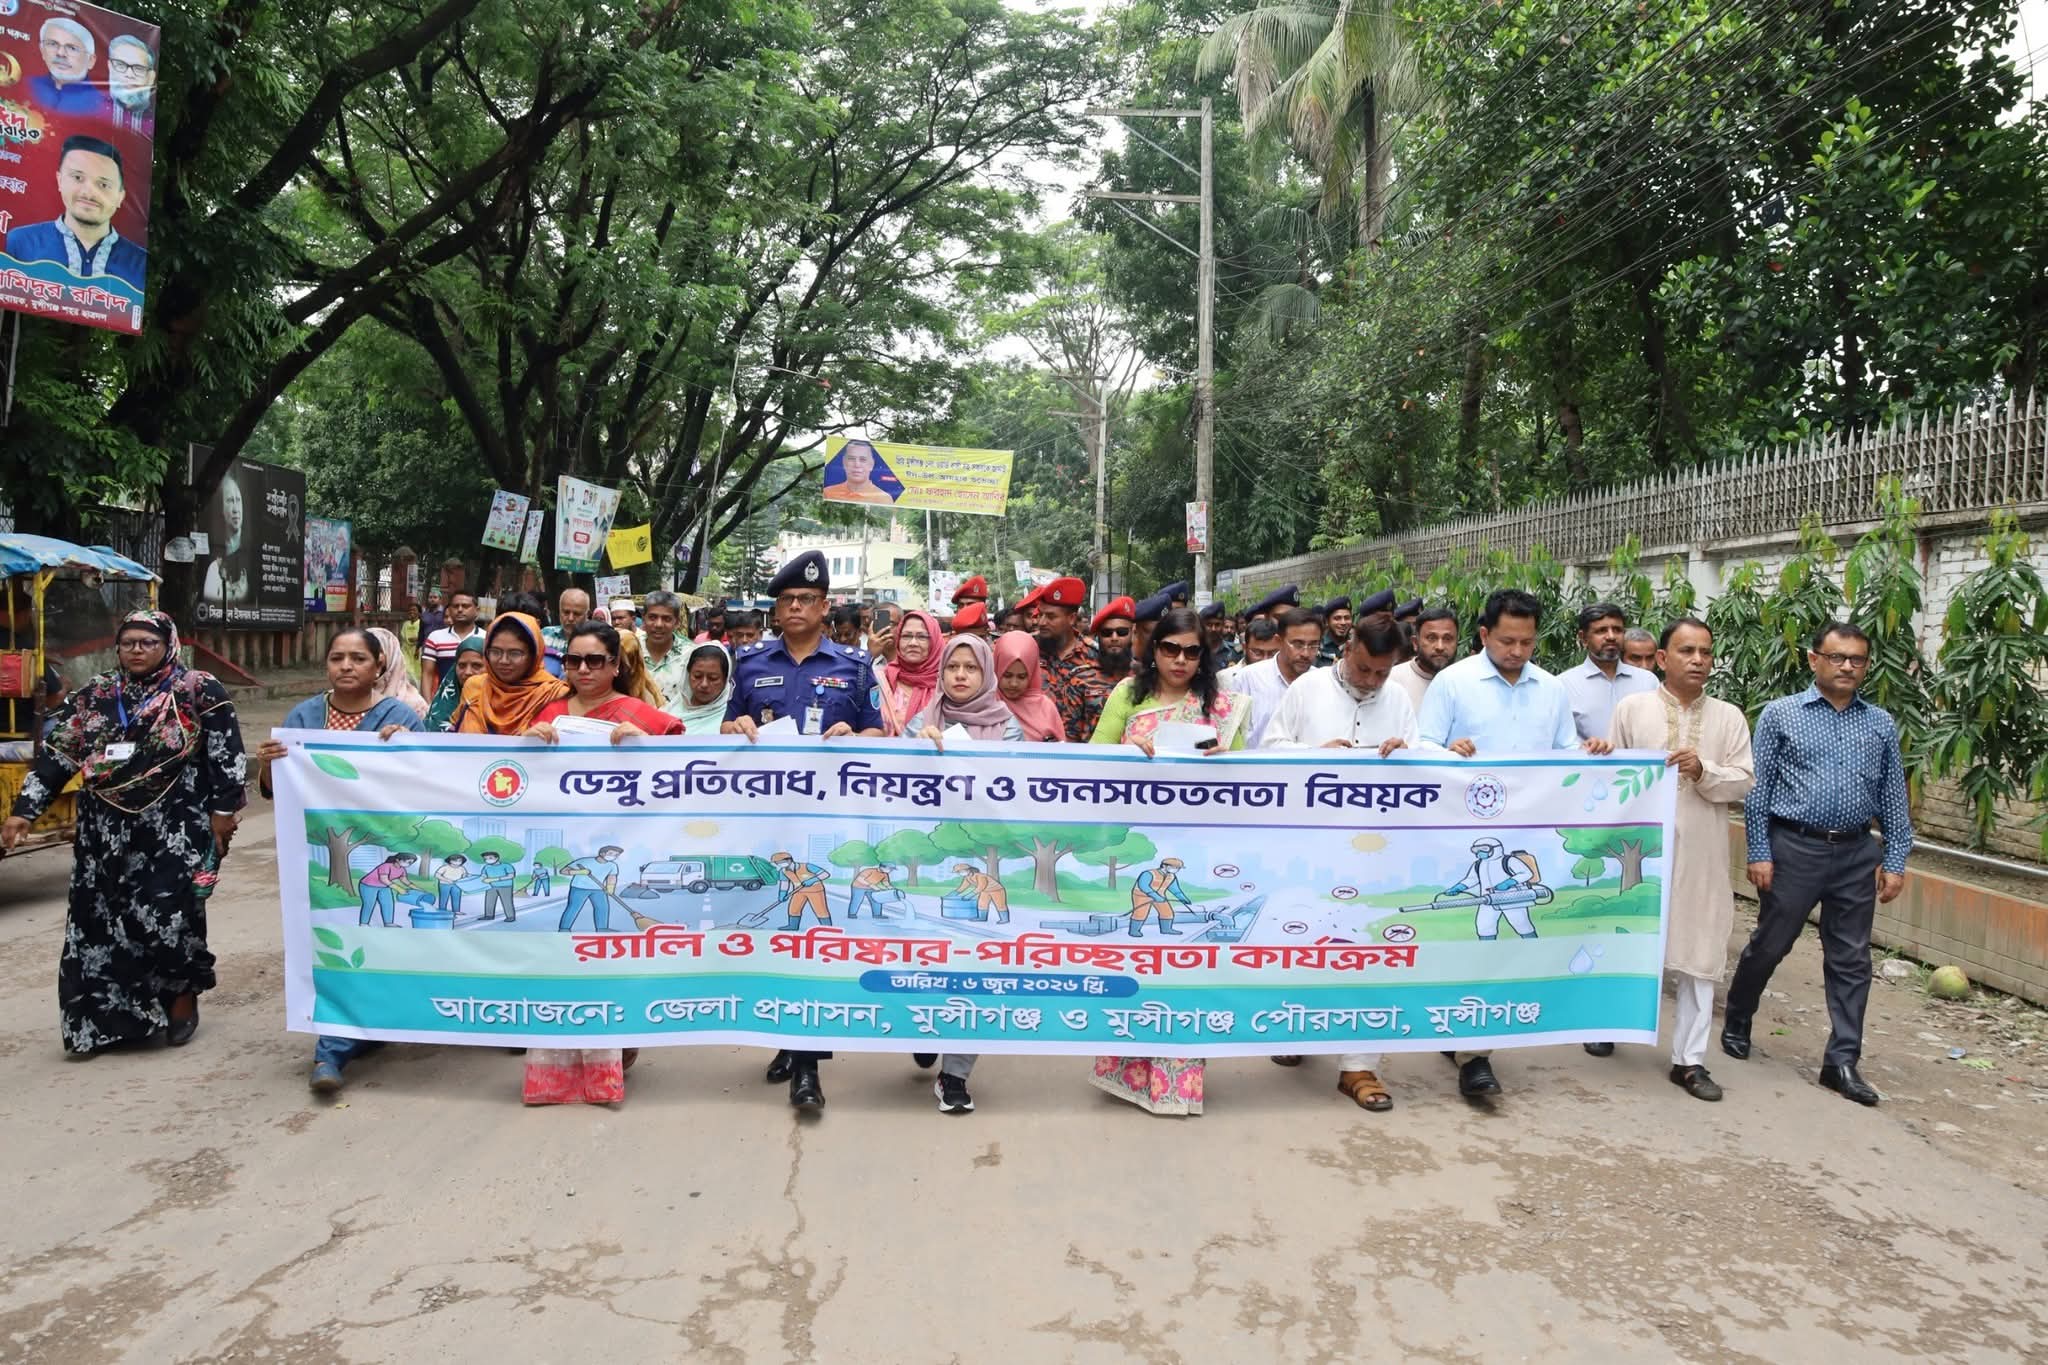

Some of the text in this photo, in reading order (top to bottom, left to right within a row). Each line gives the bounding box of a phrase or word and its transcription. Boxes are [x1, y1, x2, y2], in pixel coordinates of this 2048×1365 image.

[560, 770, 646, 807] ডেঙ্গু
[651, 759, 827, 801] প্রতিরোধ,
[838, 761, 976, 807] নিয়ন্ত্রণ
[986, 776, 1016, 802] ও
[1028, 777, 1288, 807] জনসচেতনতা
[1305, 772, 1442, 813] বিষয়ক
[718, 933, 754, 956] ও
[770, 927, 1219, 974] পরিষ্কার-পরিচ্ছন্নতা
[1232, 937, 1418, 970] কার্যক্রম
[890, 972, 949, 991] তারিখ
[962, 979, 976, 990] ৬
[982, 977, 1018, 995] জুন
[1023, 979, 1077, 992] ২০২৬
[429, 993, 1542, 1039] আয়োজনে: জেলা প্রশাসন, মুন্সীগঞ্জ ও মুন্সীগঞ্জ পৌরসভা, মুন্সীগঞ্জ
